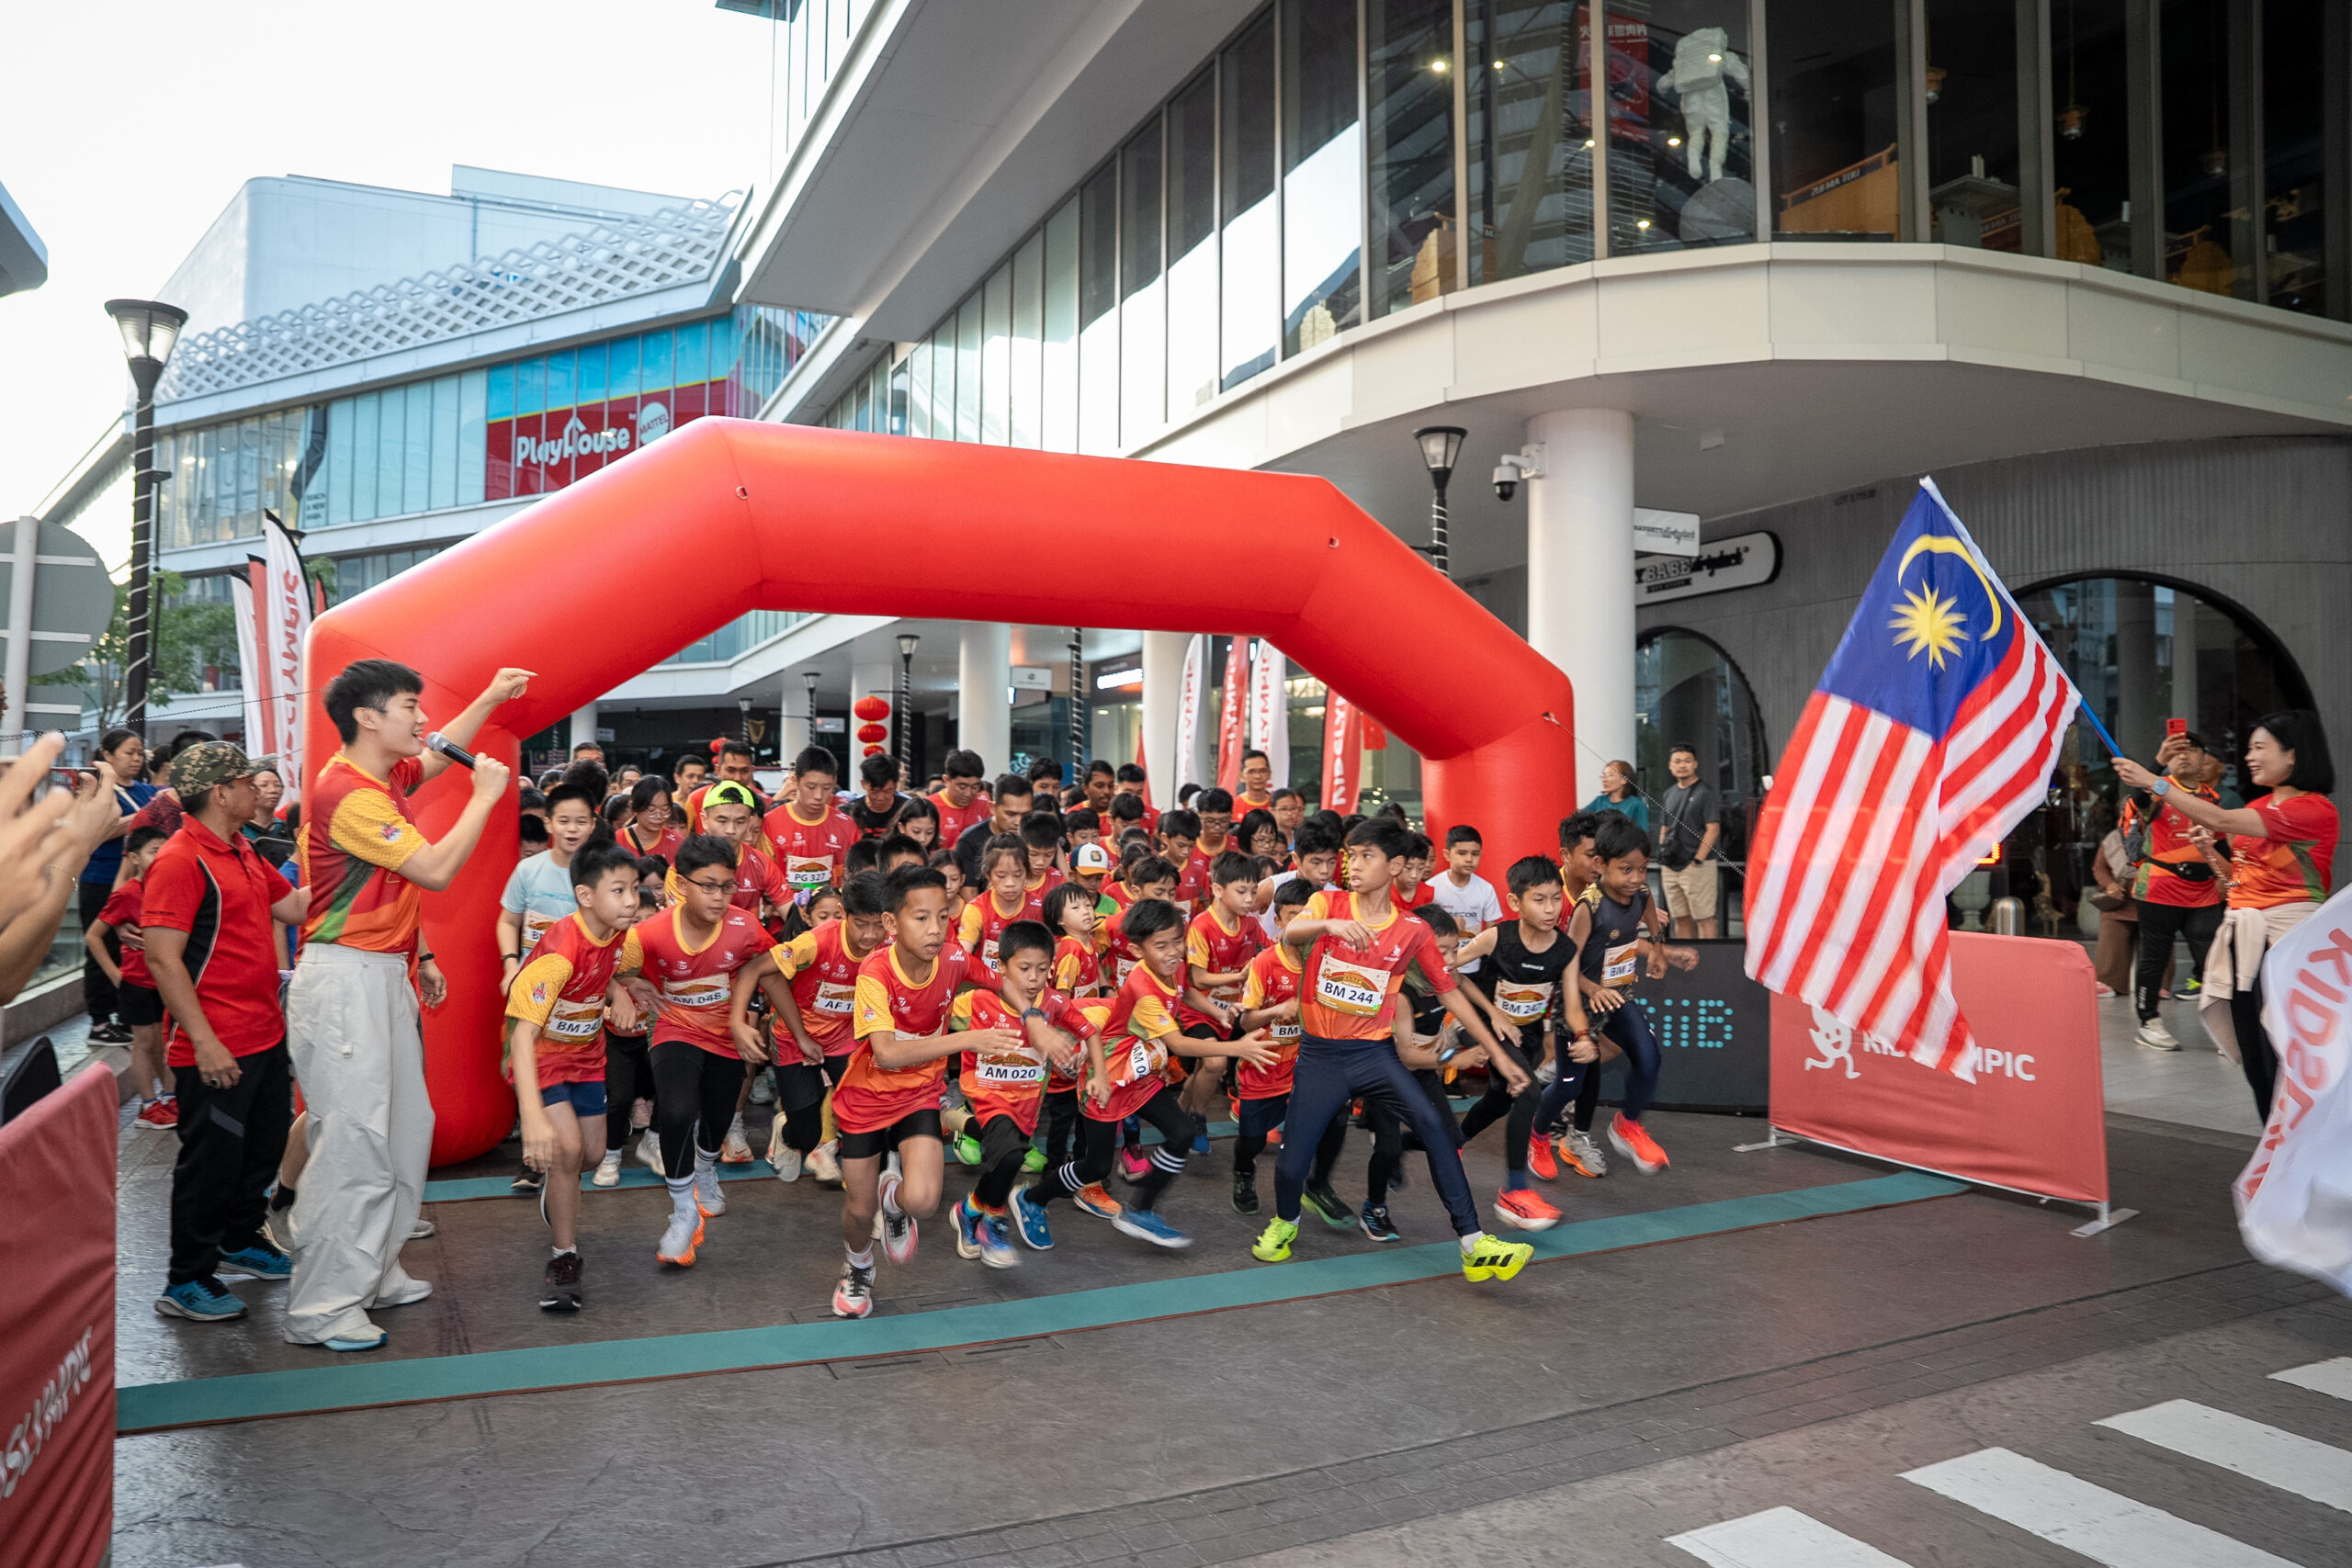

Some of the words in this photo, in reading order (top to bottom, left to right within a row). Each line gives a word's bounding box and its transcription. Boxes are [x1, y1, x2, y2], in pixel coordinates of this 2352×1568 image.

[639, 413, 669, 436] MATTEL
[794, 874, 808, 882] PG
[809, 873, 826, 882] 327
[1609, 964, 1626, 977] BM
[673, 997, 695, 1005] AM
[697, 992, 722, 1004] 048
[1324, 982, 1346, 998] BM
[1348, 989, 1374, 1004] 244
[824, 1000, 843, 1010] AF
[1501, 1000, 1521, 1015] BM
[557, 1021, 581, 1033] BM
[1278, 1026, 1298, 1036] BM
[1134, 1045, 1145, 1064] AM
[984, 1066, 1008, 1079] AM
[1011, 1068, 1036, 1079] 020
